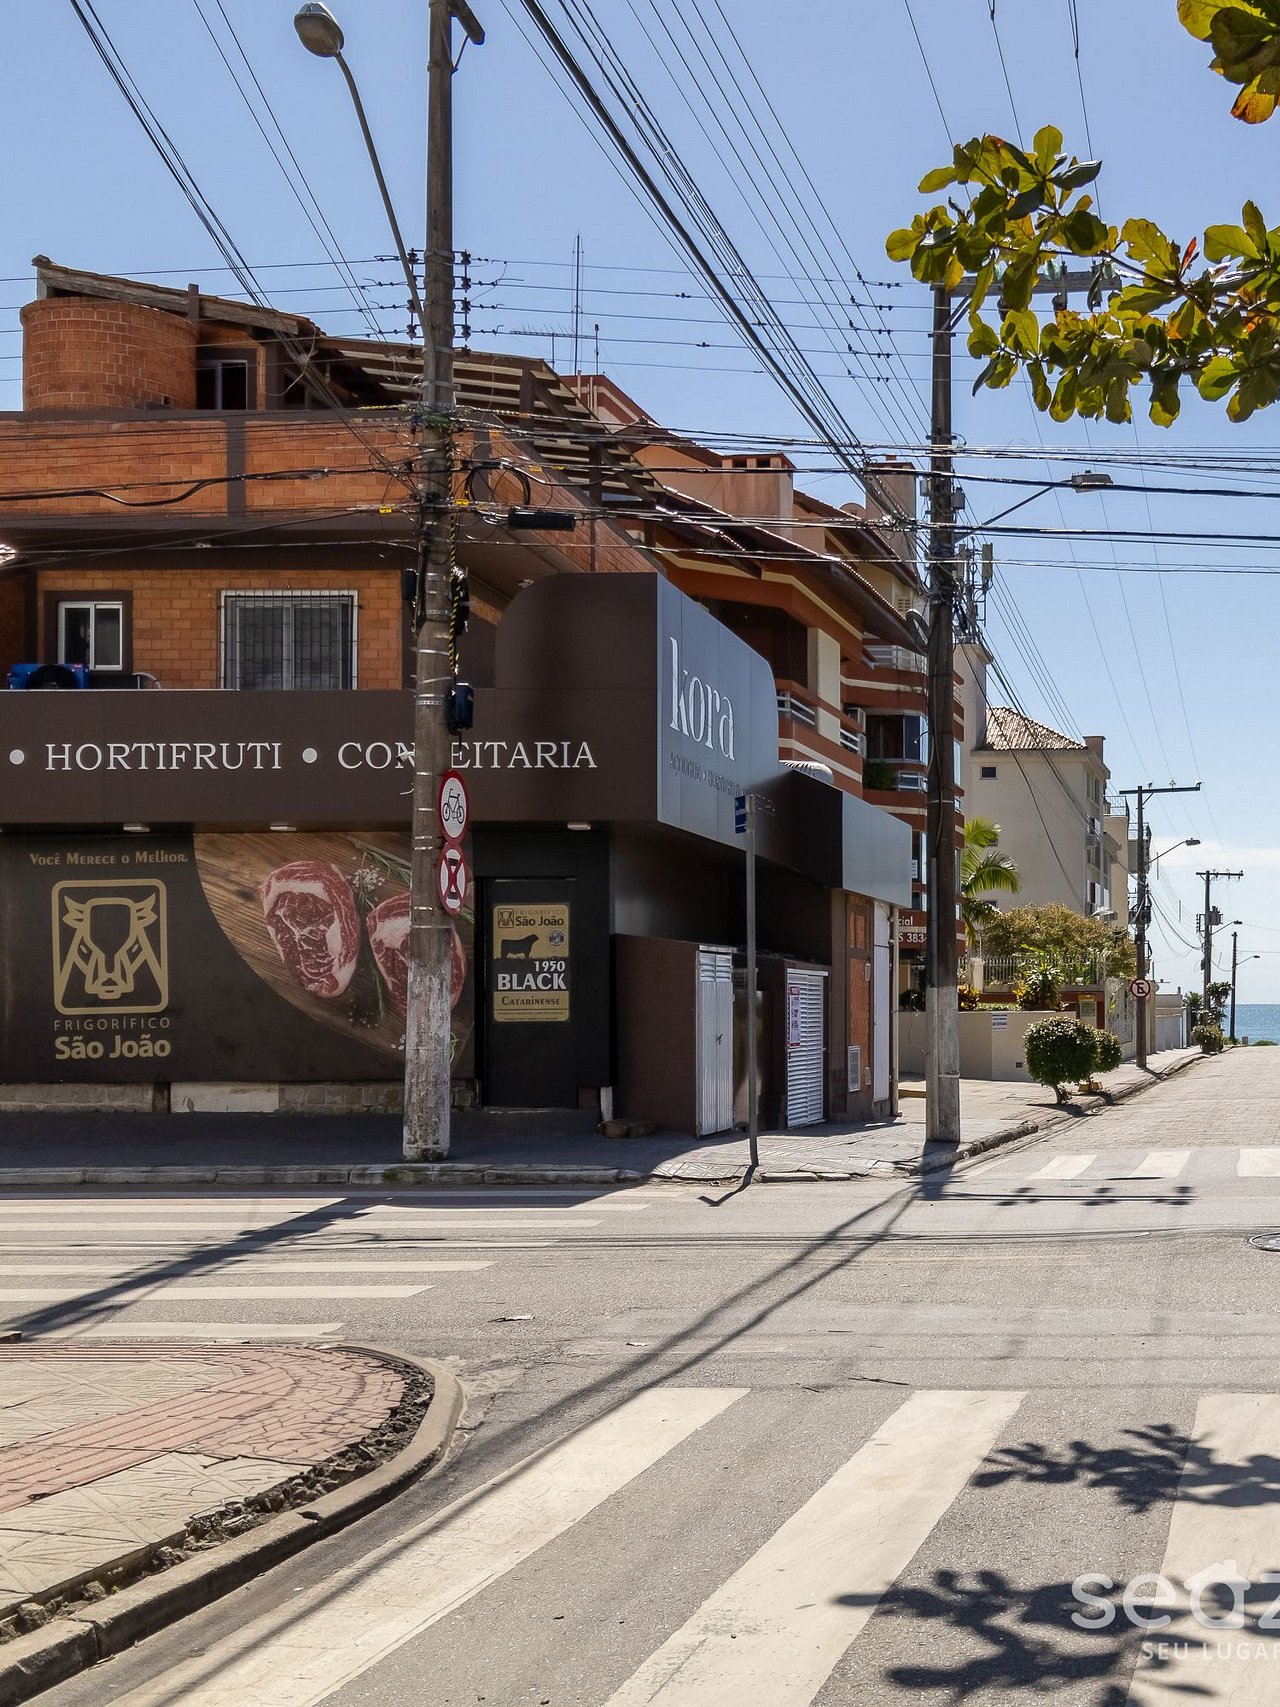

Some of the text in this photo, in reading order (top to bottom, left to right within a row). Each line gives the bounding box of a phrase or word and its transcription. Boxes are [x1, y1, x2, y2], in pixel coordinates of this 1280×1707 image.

[669, 636, 736, 762] kora
[45, 741, 598, 771] HORTIFRUTI CONEITARIA
[515, 916, 564, 927] São João
[898, 915, 913, 926] cial
[534, 961, 566, 972] 1950
[497, 973, 567, 990] BLACK
[54, 1017, 170, 1031] FRIGORÍFICO
[54, 1034, 171, 1060] São João
